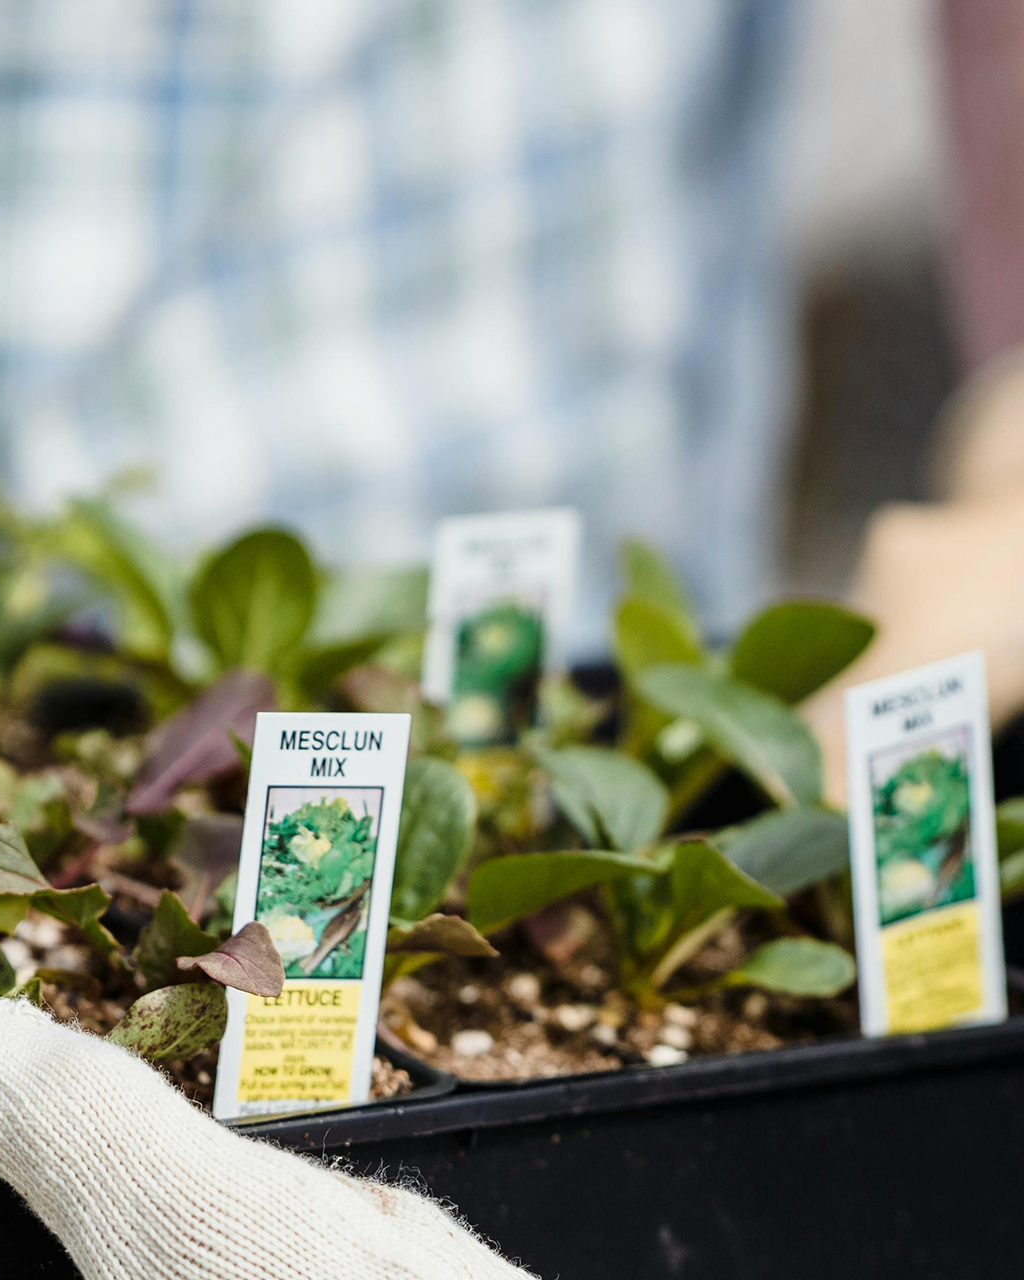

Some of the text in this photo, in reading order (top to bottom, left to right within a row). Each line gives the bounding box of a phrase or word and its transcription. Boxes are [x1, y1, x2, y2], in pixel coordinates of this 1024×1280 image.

[279, 730, 384, 751] MESCLUN
[310, 757, 348, 777] MIX
[263, 990, 343, 1006] LETTUCE
[255, 1066, 278, 1076] HOW
[284, 1066, 295, 1076] TO
